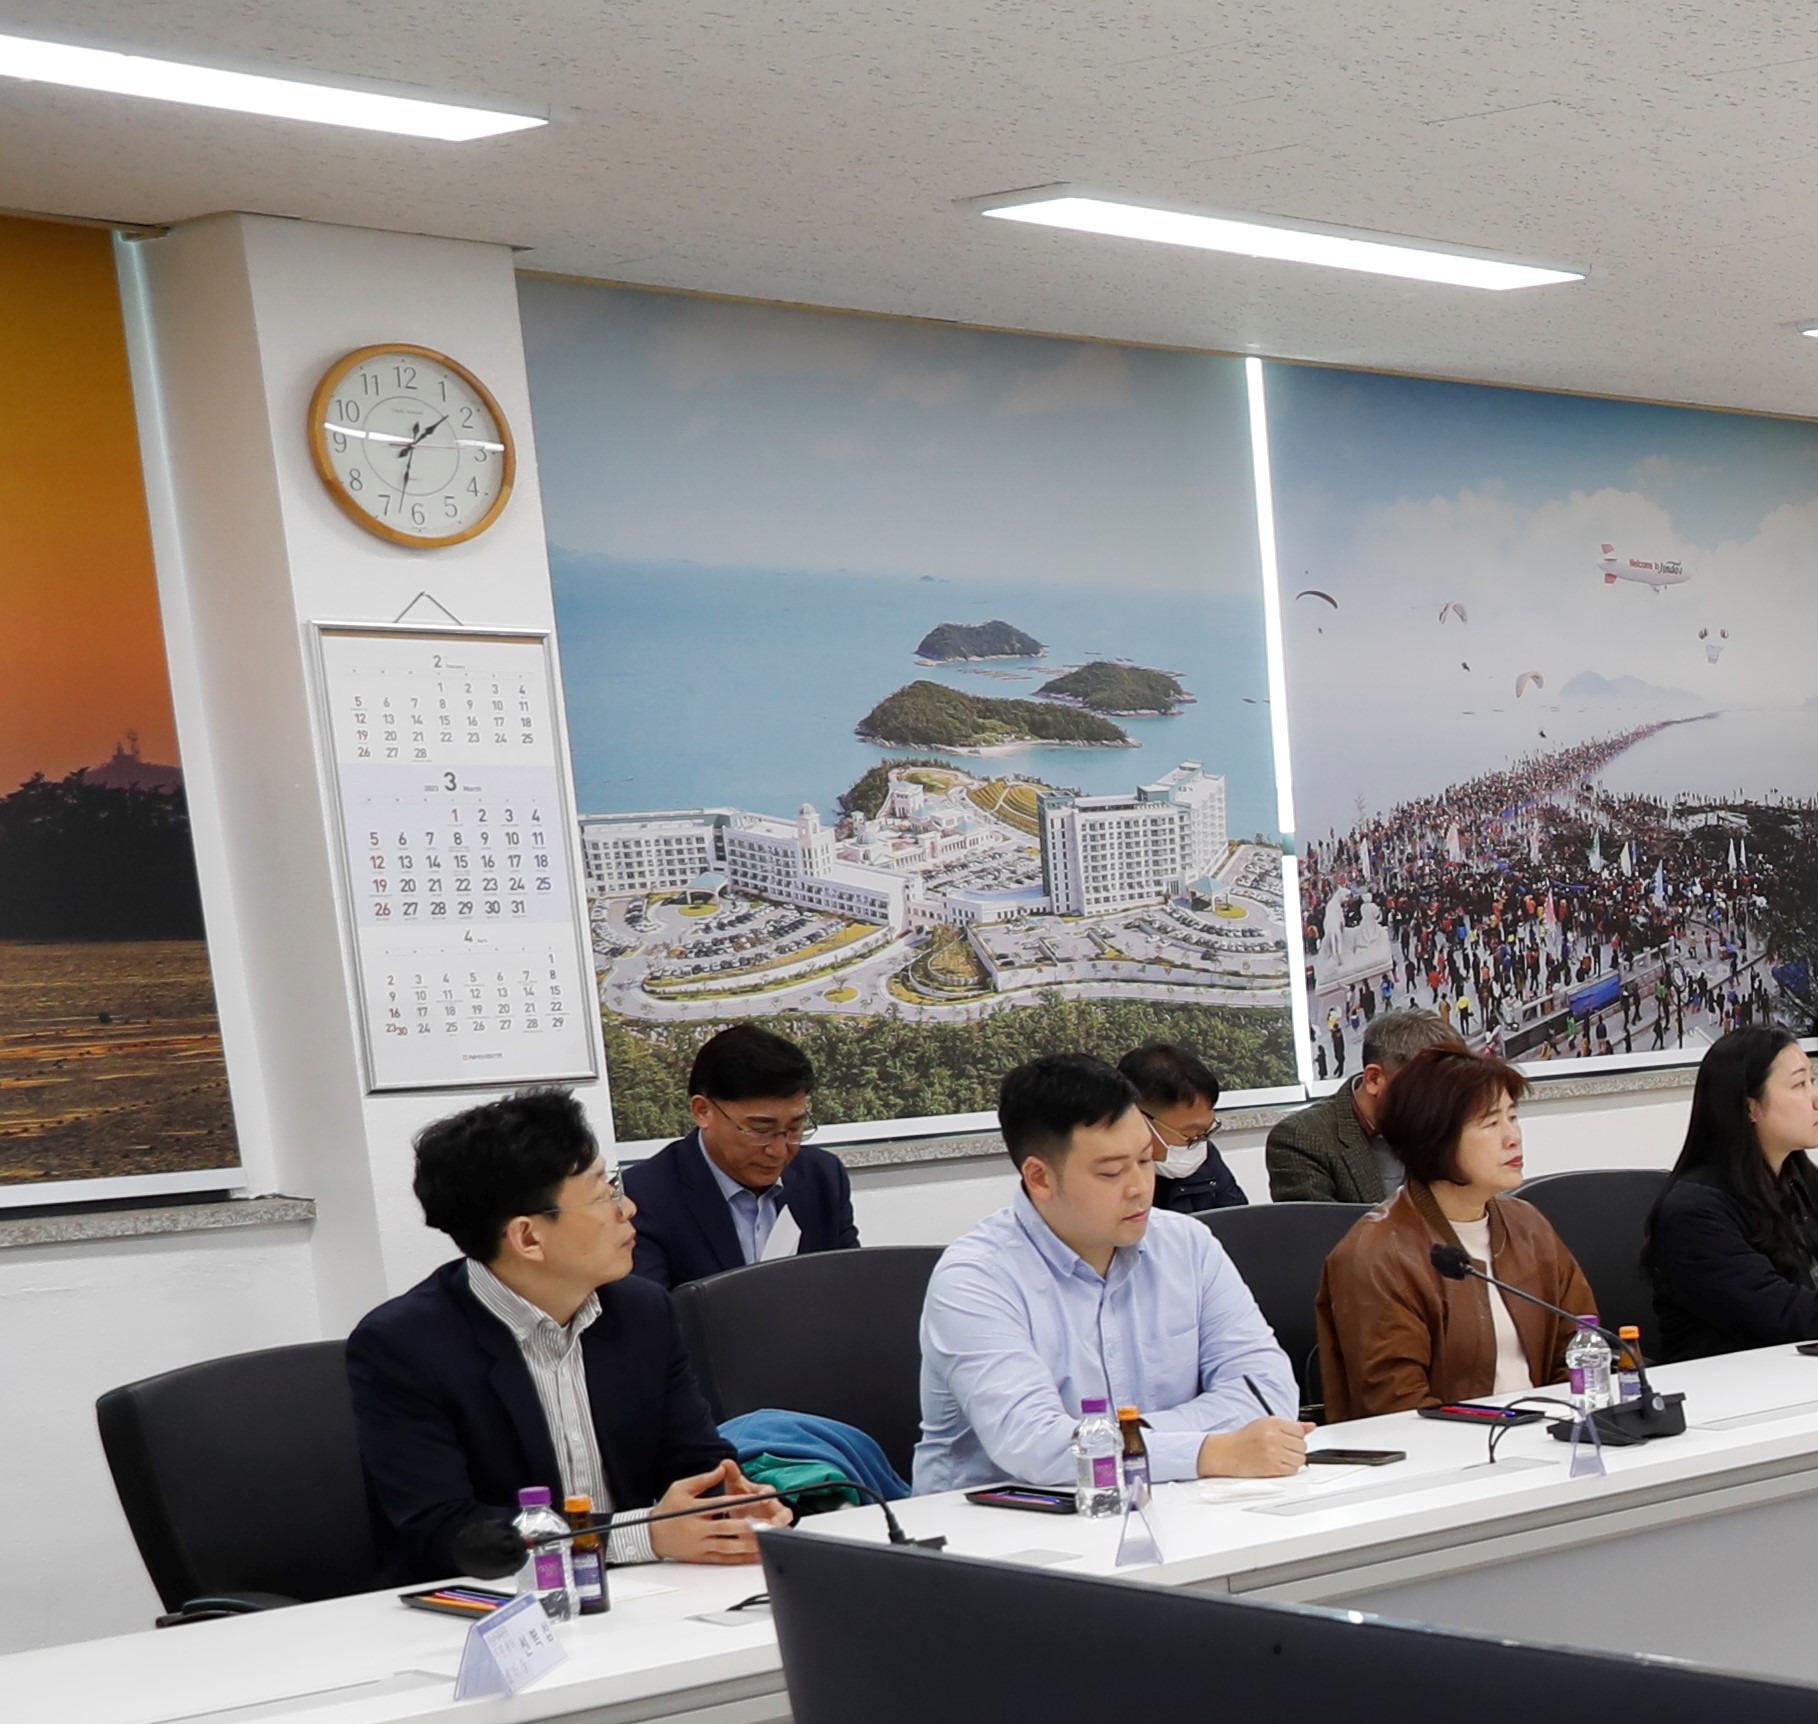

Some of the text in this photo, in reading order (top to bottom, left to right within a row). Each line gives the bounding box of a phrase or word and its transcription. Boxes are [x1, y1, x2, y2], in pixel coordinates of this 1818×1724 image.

[361, 373, 379, 396] 11
[393, 366, 417, 389] 12
[438, 381, 446, 402] 1
[336, 400, 360, 423] 10
[460, 407, 473, 428] 2
[333, 431, 347, 453] 9
[350, 468, 363, 491] 8
[467, 476, 479, 496] 4
[378, 495, 390, 515] 7
[444, 497, 457, 517] 5
[411, 503, 425, 525] 6
[433, 655, 442, 668] 2
[438, 682, 526, 695] 1 2 3 4
[355, 696, 529, 712] 5 6 7 8 9 10 11
[354, 713, 532, 728] 12 13 14 15 16 17 18
[356, 730, 534, 744] 19 20 21 22 23 24 25
[358, 747, 427, 759] 26 27 28
[444, 772, 457, 791] 3
[452, 809, 540, 822] 1 2 3 4
[370, 832, 544, 846] 5 6 7 8 9 10 11
[370, 854, 548, 869] 12 13 14 15 16 17 18
[373, 877, 550, 892] 19 20 21 22 23 24 25
[376, 900, 525, 916] 26 27 28 29 30 31
[464, 930, 473, 943] 4
[549, 954, 554, 964] 1
[387, 970, 556, 986] 2 3 4 5 6 7 8
[389, 985, 561, 1002] 9 10 11 12 13 14 15
[389, 1002, 562, 1018] 16 17 18 19 20 21 22
[385, 1017, 564, 1036] 23 30 24 25 26 27 28 29
